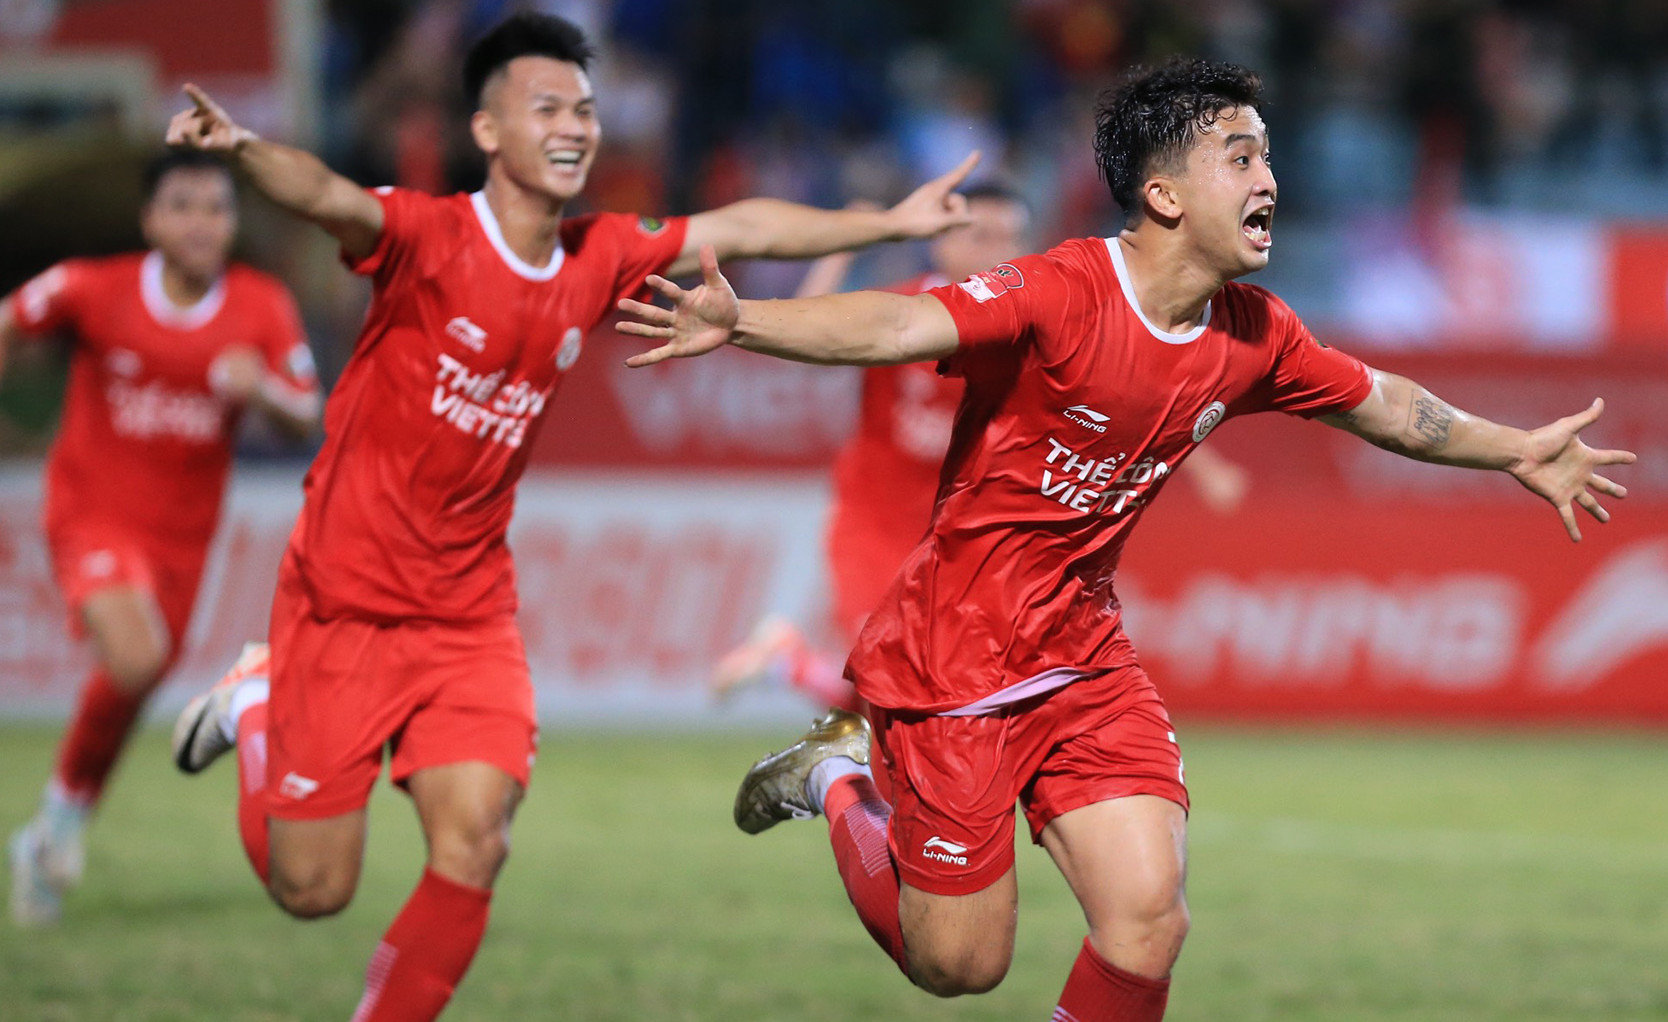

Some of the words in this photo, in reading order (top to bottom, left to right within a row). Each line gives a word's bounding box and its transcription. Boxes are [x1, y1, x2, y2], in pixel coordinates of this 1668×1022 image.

[1063, 409, 1107, 434] LI-NING
[1046, 437, 1126, 486] THỂ
[922, 848, 968, 866] LI-NING
